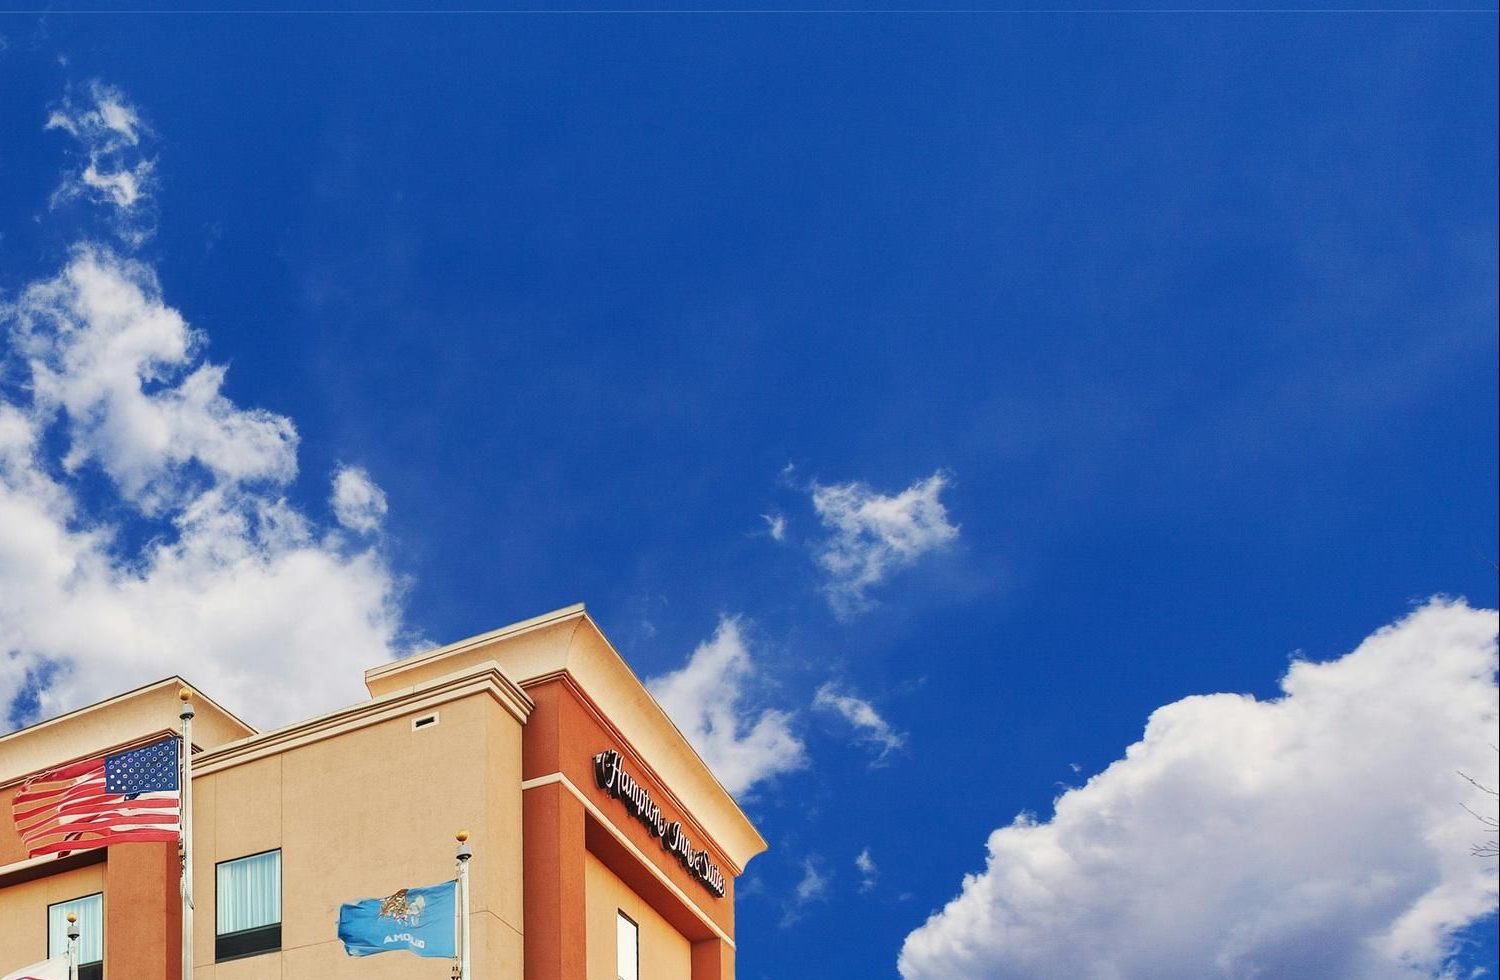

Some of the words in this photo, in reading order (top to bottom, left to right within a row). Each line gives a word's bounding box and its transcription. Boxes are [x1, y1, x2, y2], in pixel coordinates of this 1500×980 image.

[597, 749, 668, 837] Hampton
[666, 821, 696, 868] Inn
[701, 850, 726, 897] Suites
